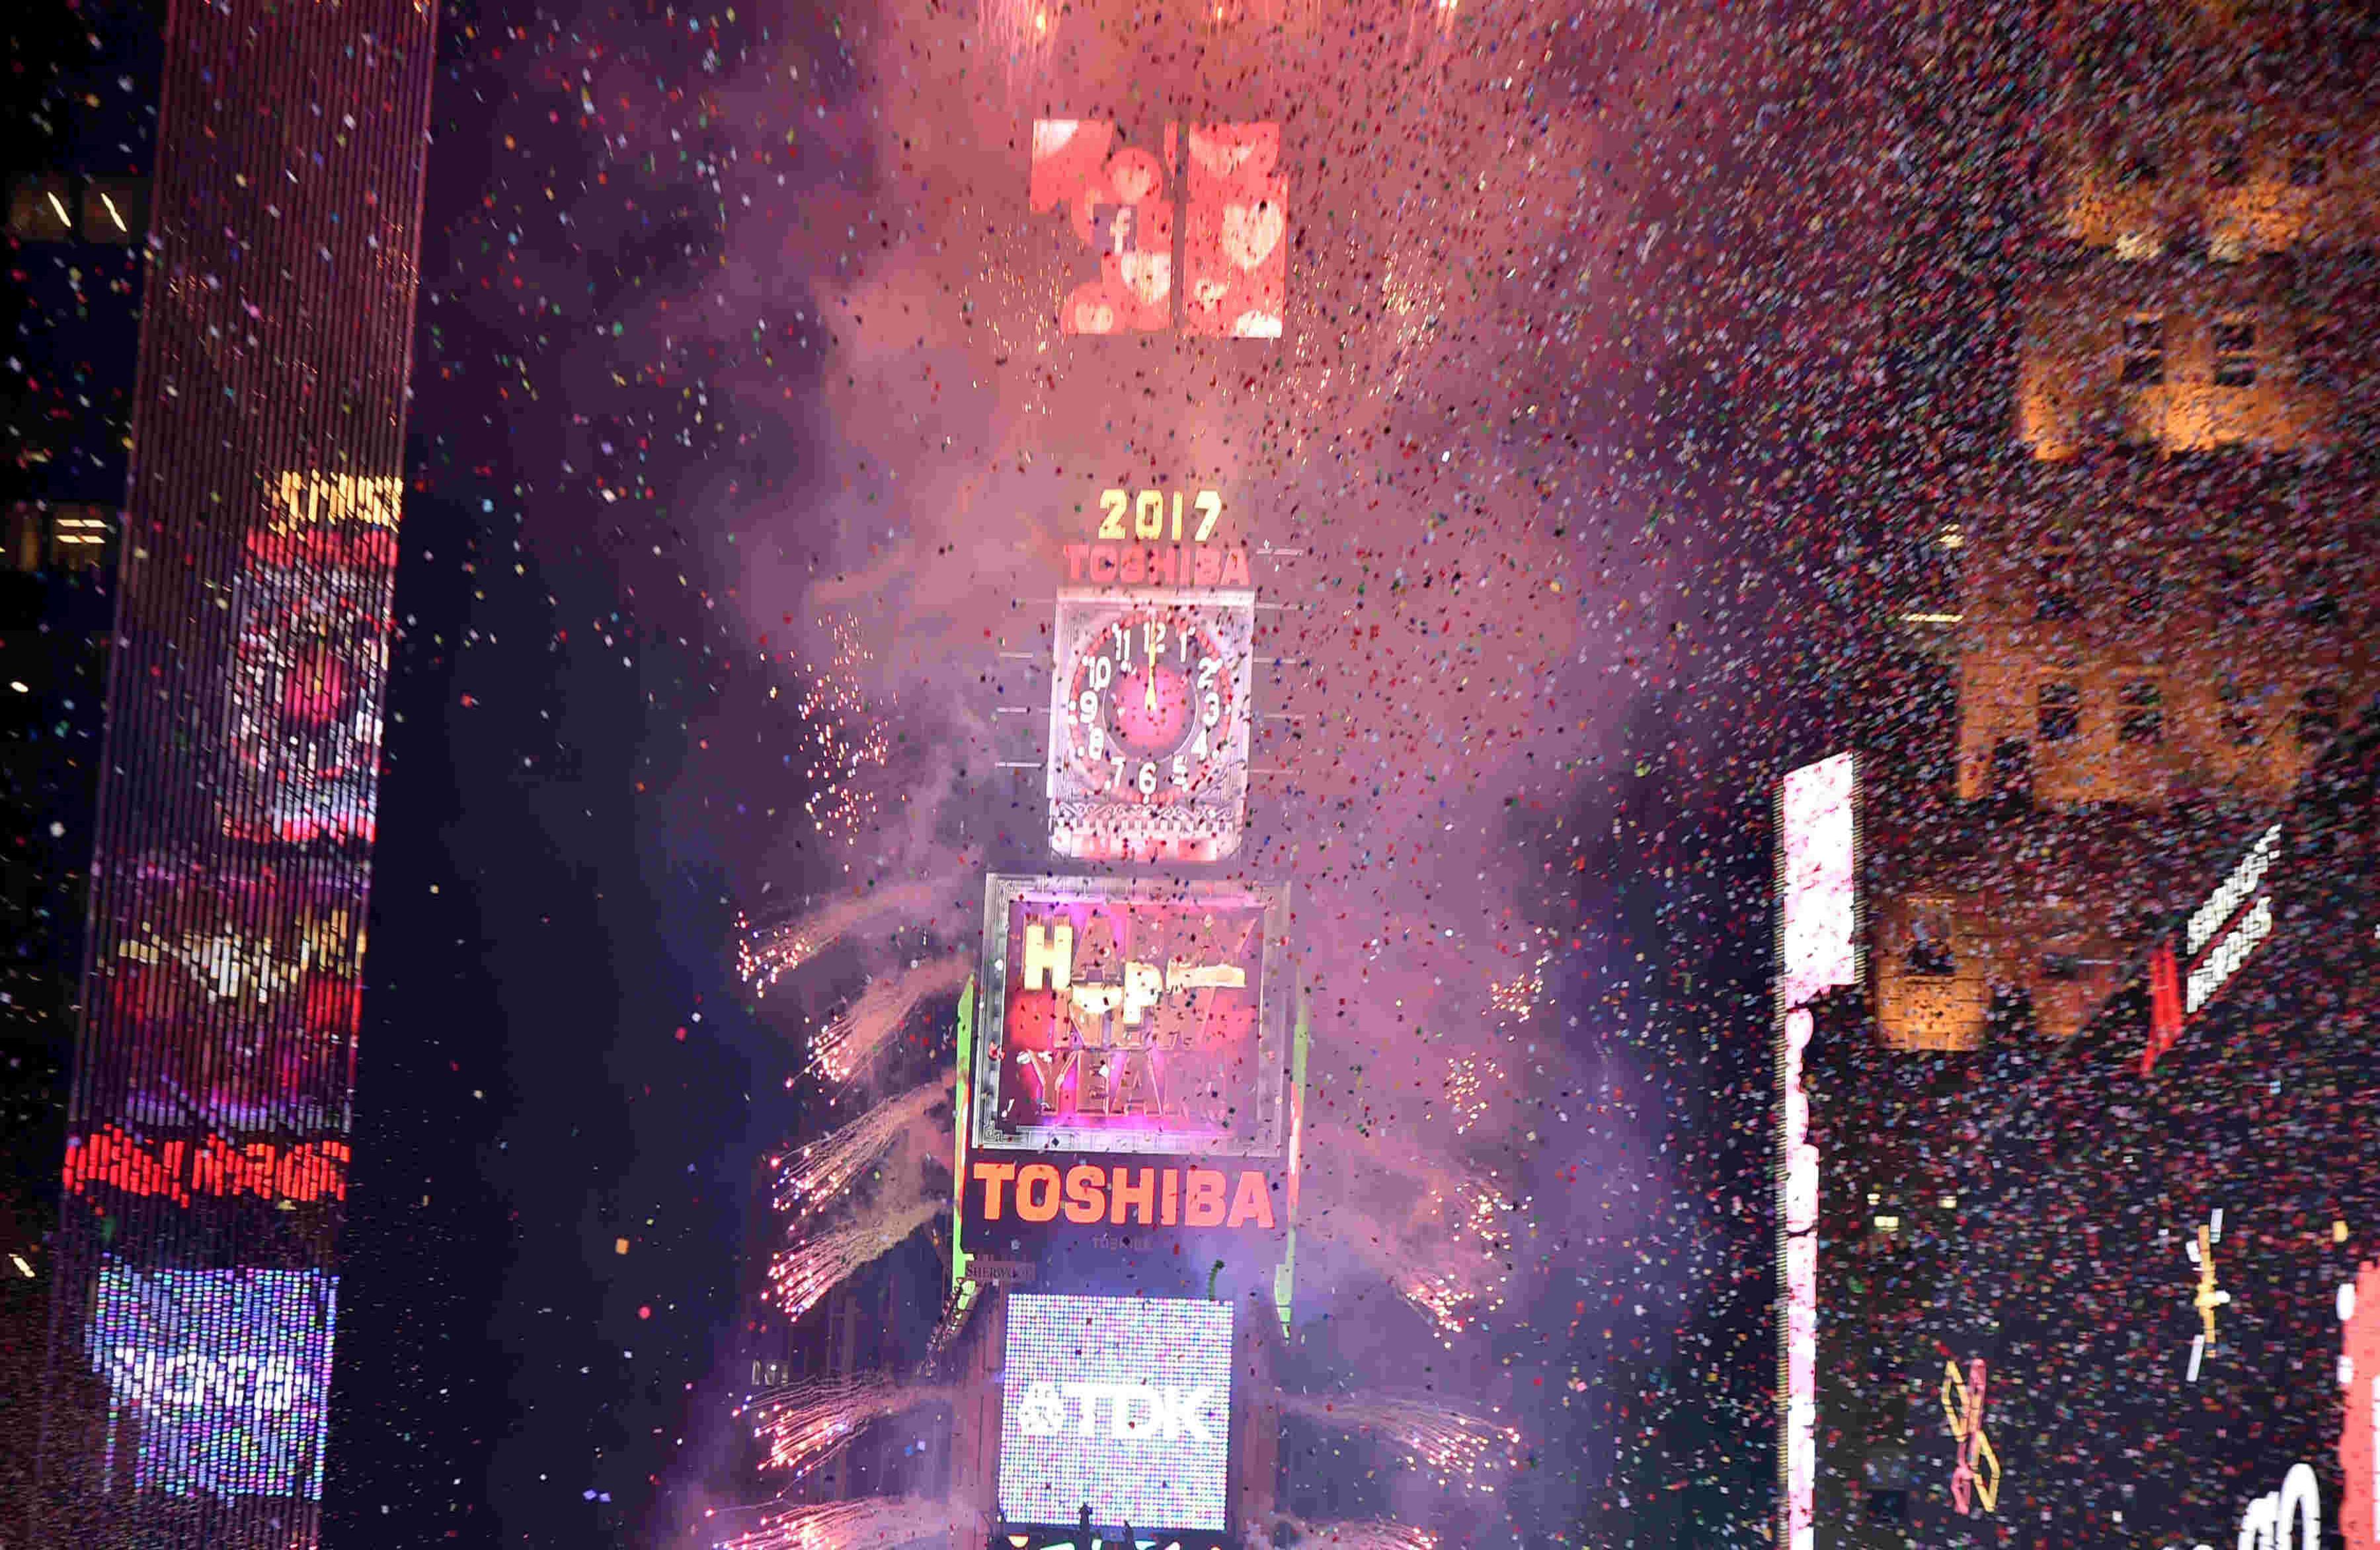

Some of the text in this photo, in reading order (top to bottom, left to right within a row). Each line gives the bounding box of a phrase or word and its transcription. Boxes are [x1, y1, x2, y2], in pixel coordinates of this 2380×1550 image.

[1098, 489, 1222, 541] 2017
[1064, 545, 1250, 585] TOSHIBA
[1111, 623, 1131, 661] 11
[1143, 622, 1166, 653] 12
[1082, 656, 1111, 690] 10
[1197, 657, 1222, 690] 2
[1079, 691, 1098, 724] 9
[1203, 692, 1220, 726] 3
[1088, 727, 1105, 760] 8
[1191, 729, 1209, 760] 4
[1111, 756, 1126, 788] 7
[1138, 762, 1158, 795] 6
[972, 1162, 1275, 1229] TOSHIBA
[1062, 1384, 1214, 1440] TDK
